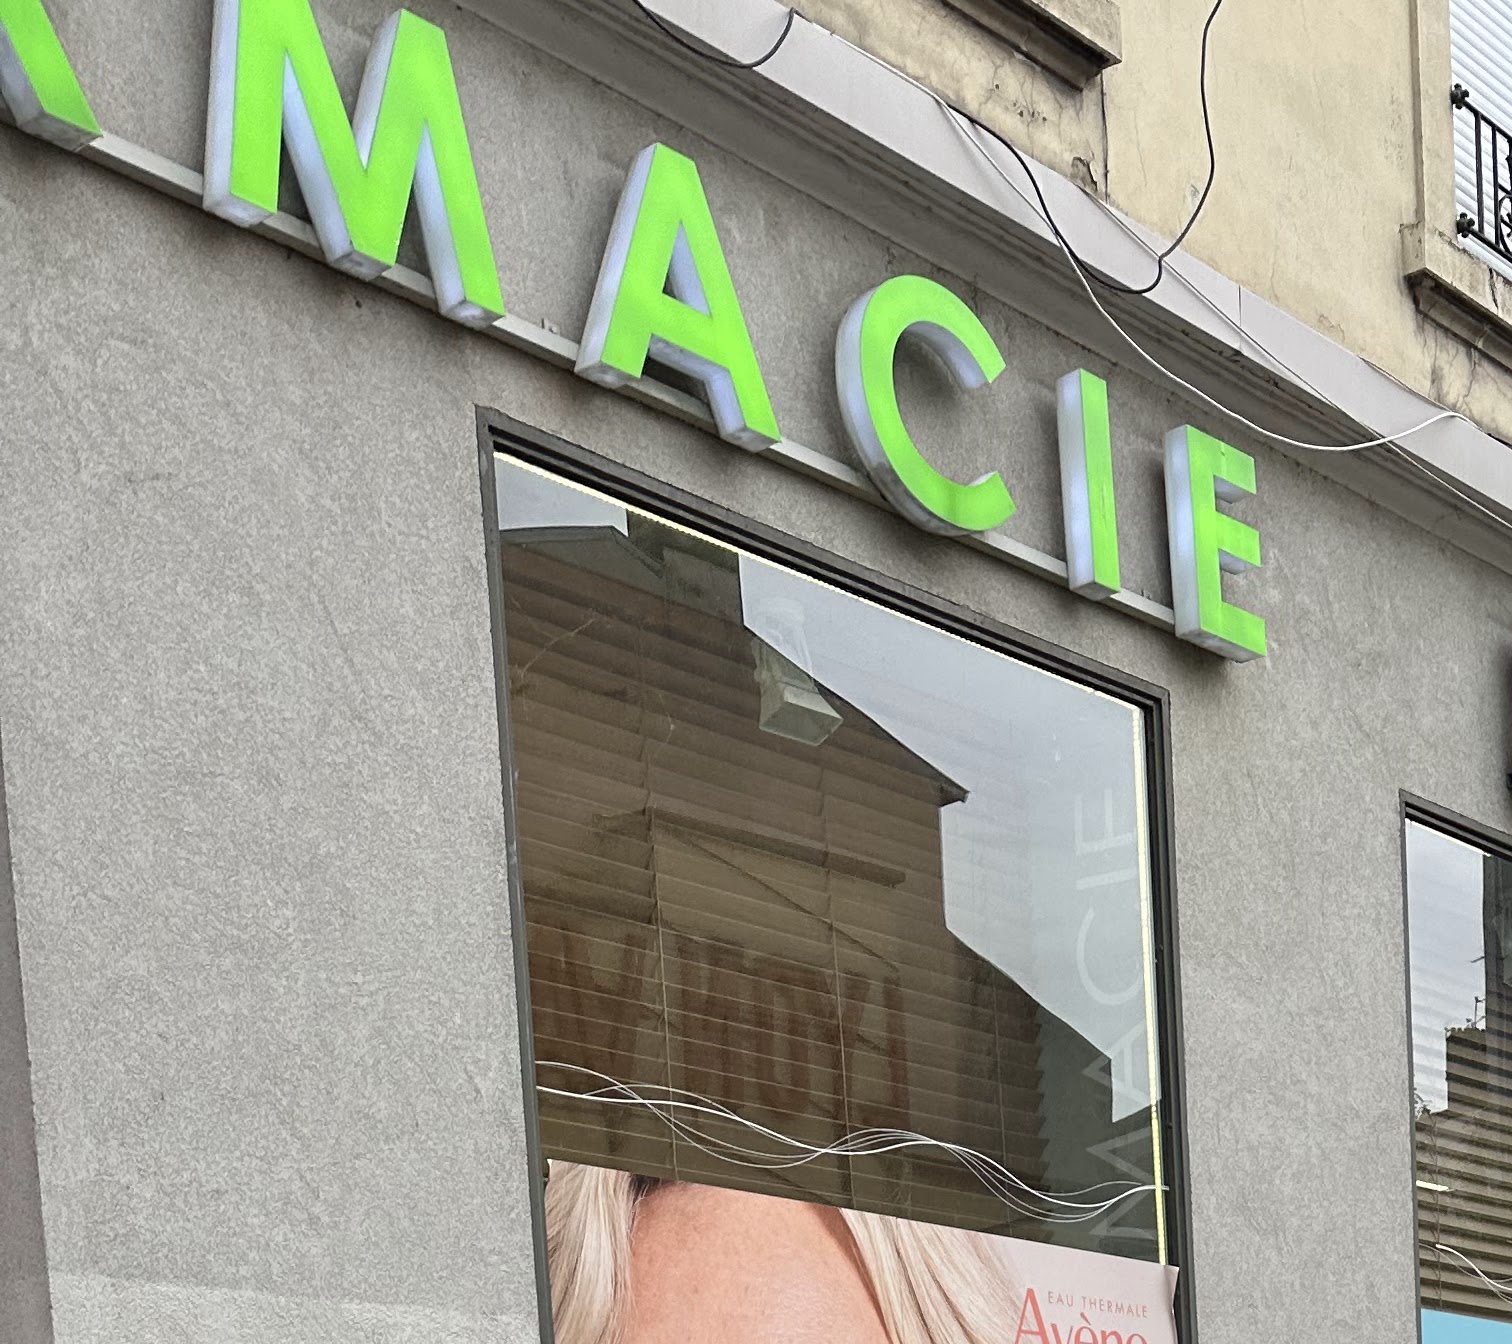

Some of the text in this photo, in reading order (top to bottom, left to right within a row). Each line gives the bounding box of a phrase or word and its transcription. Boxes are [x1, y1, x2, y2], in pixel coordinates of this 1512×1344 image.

[0, 0, 1268, 663] MACIE
[1047, 1290, 1148, 1319] EAU THERMALE
